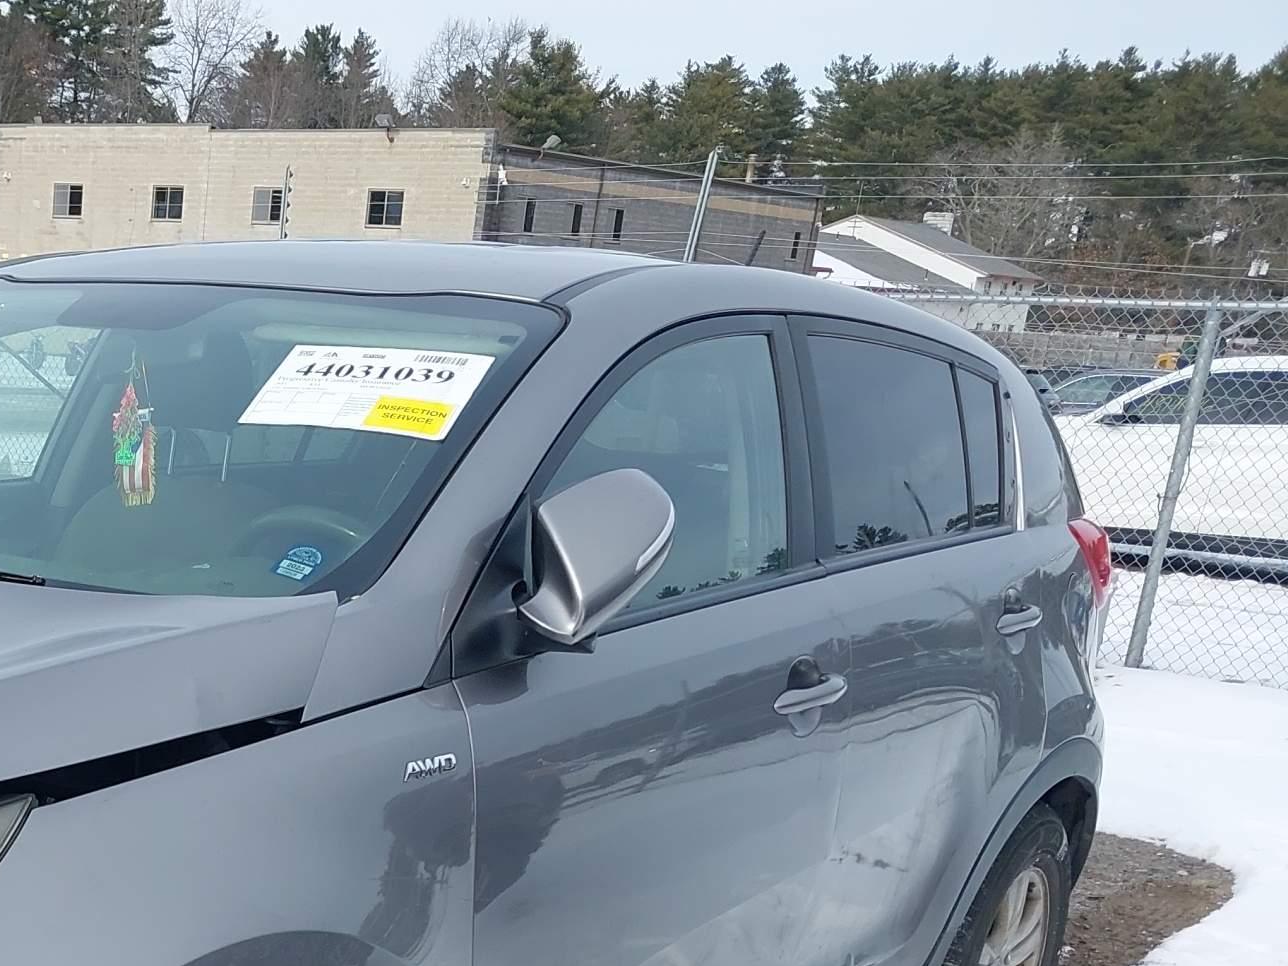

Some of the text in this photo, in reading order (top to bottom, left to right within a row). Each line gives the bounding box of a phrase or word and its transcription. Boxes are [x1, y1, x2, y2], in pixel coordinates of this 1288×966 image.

[295, 362, 456, 384] 44031039
[377, 403, 448, 418] INSPECTION
[381, 412, 434, 425] SERVICE
[402, 753, 457, 783] AWD
